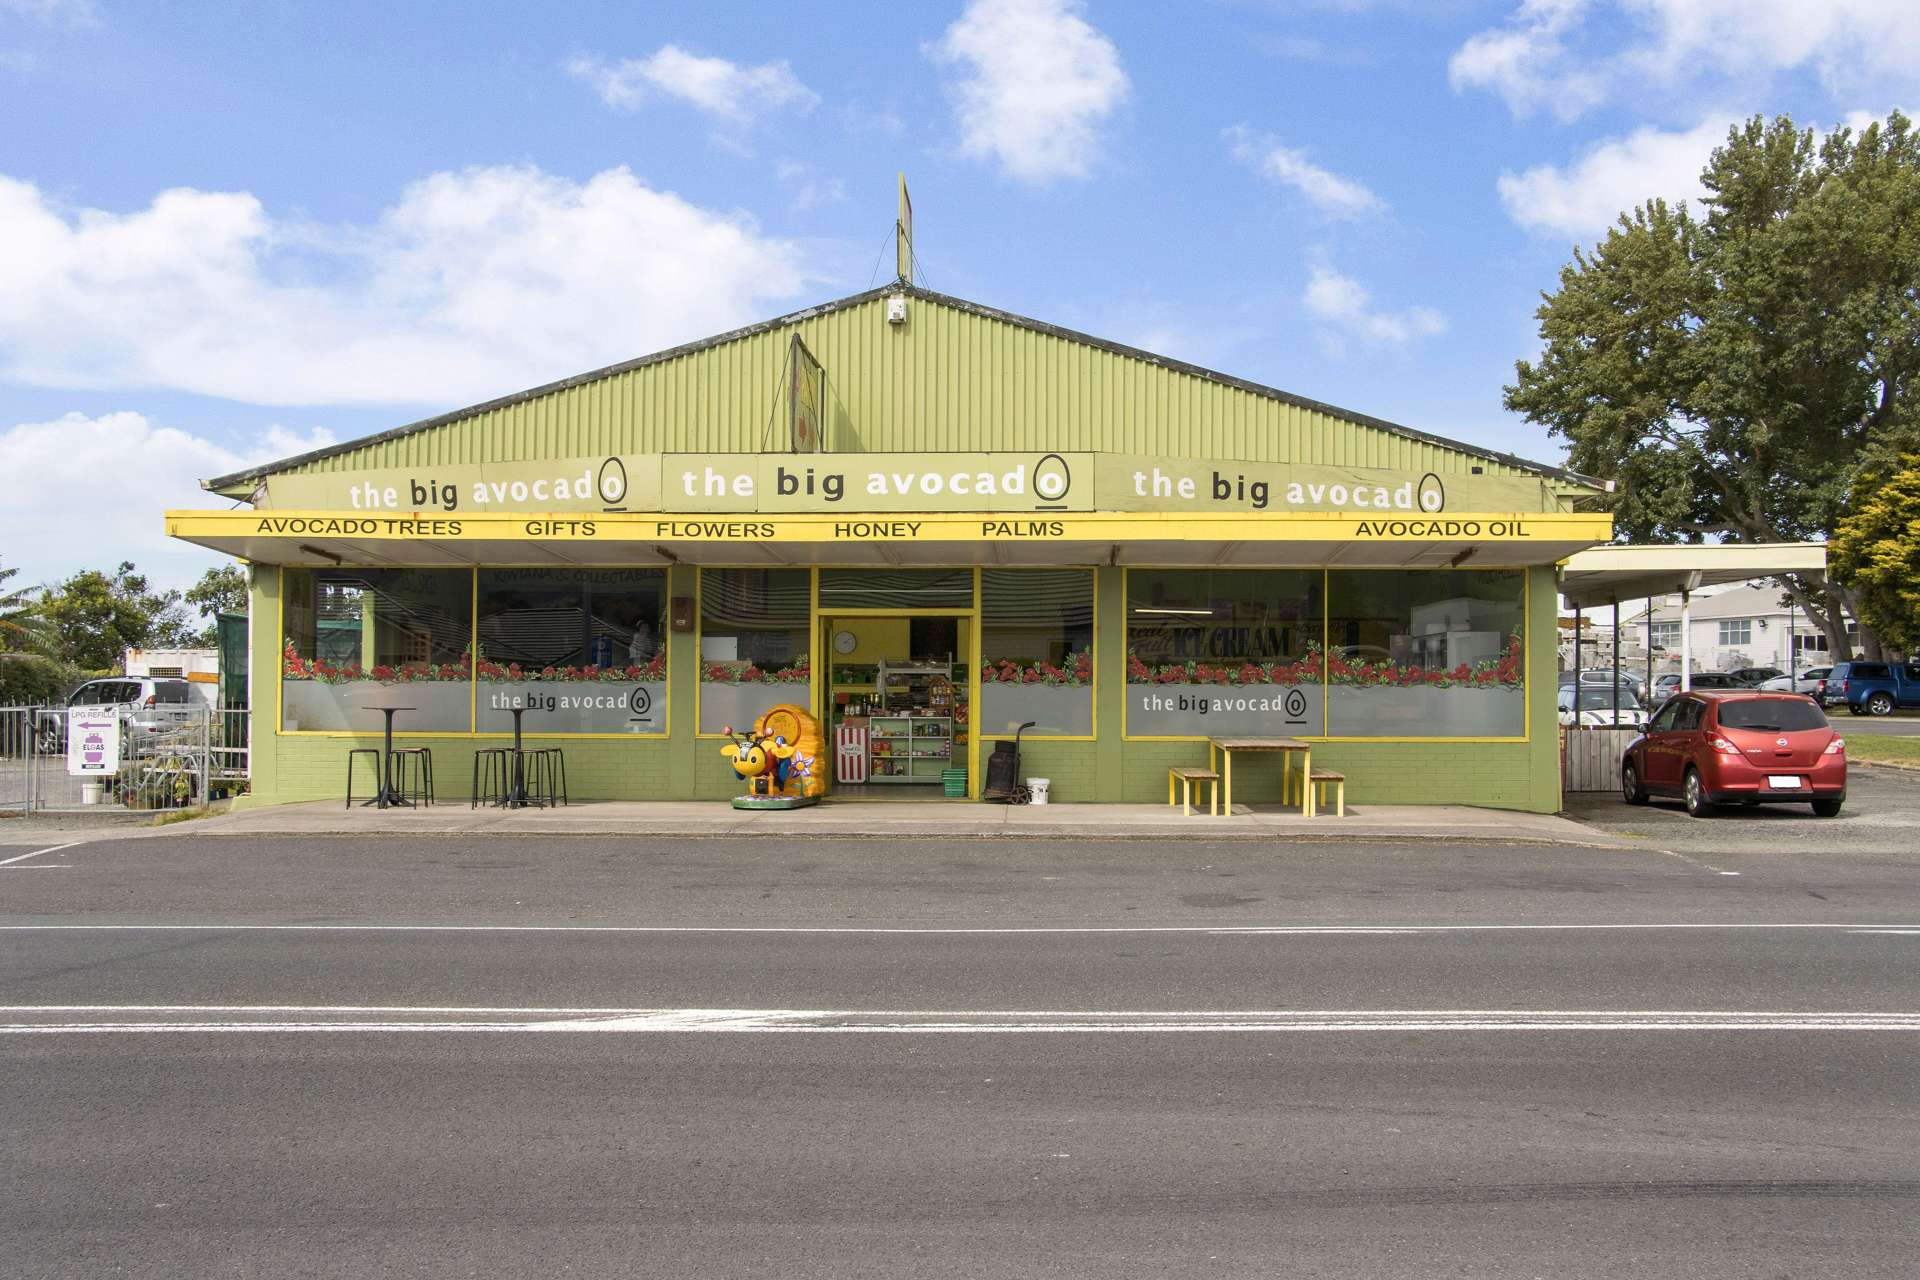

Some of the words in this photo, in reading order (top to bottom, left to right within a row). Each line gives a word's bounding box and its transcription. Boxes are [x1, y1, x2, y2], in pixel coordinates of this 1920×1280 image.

[350, 481, 398, 509] the
[410, 478, 458, 511] big
[472, 470, 623, 503] avocado
[682, 467, 754, 496] the
[777, 467, 845, 502] big
[866, 464, 1065, 496] avocado
[1133, 467, 1196, 499] the
[1212, 471, 1269, 509] big
[1286, 480, 1442, 512] avocado
[256, 518, 379, 535] AVOCADO
[383, 519, 463, 536] TREES
[525, 521, 597, 537] GIFTS
[656, 522, 776, 538] FLOWERS
[834, 522, 922, 538] HONEY
[982, 521, 1065, 537] PALMS
[1355, 521, 1481, 537] AVOCADO
[1489, 521, 1531, 537] OIL
[491, 691, 521, 710] the
[526, 690, 556, 713] big
[560, 691, 647, 710] avocado
[1142, 694, 1174, 712] the
[1178, 694, 1209, 716] big
[1212, 694, 1302, 713] avocado
